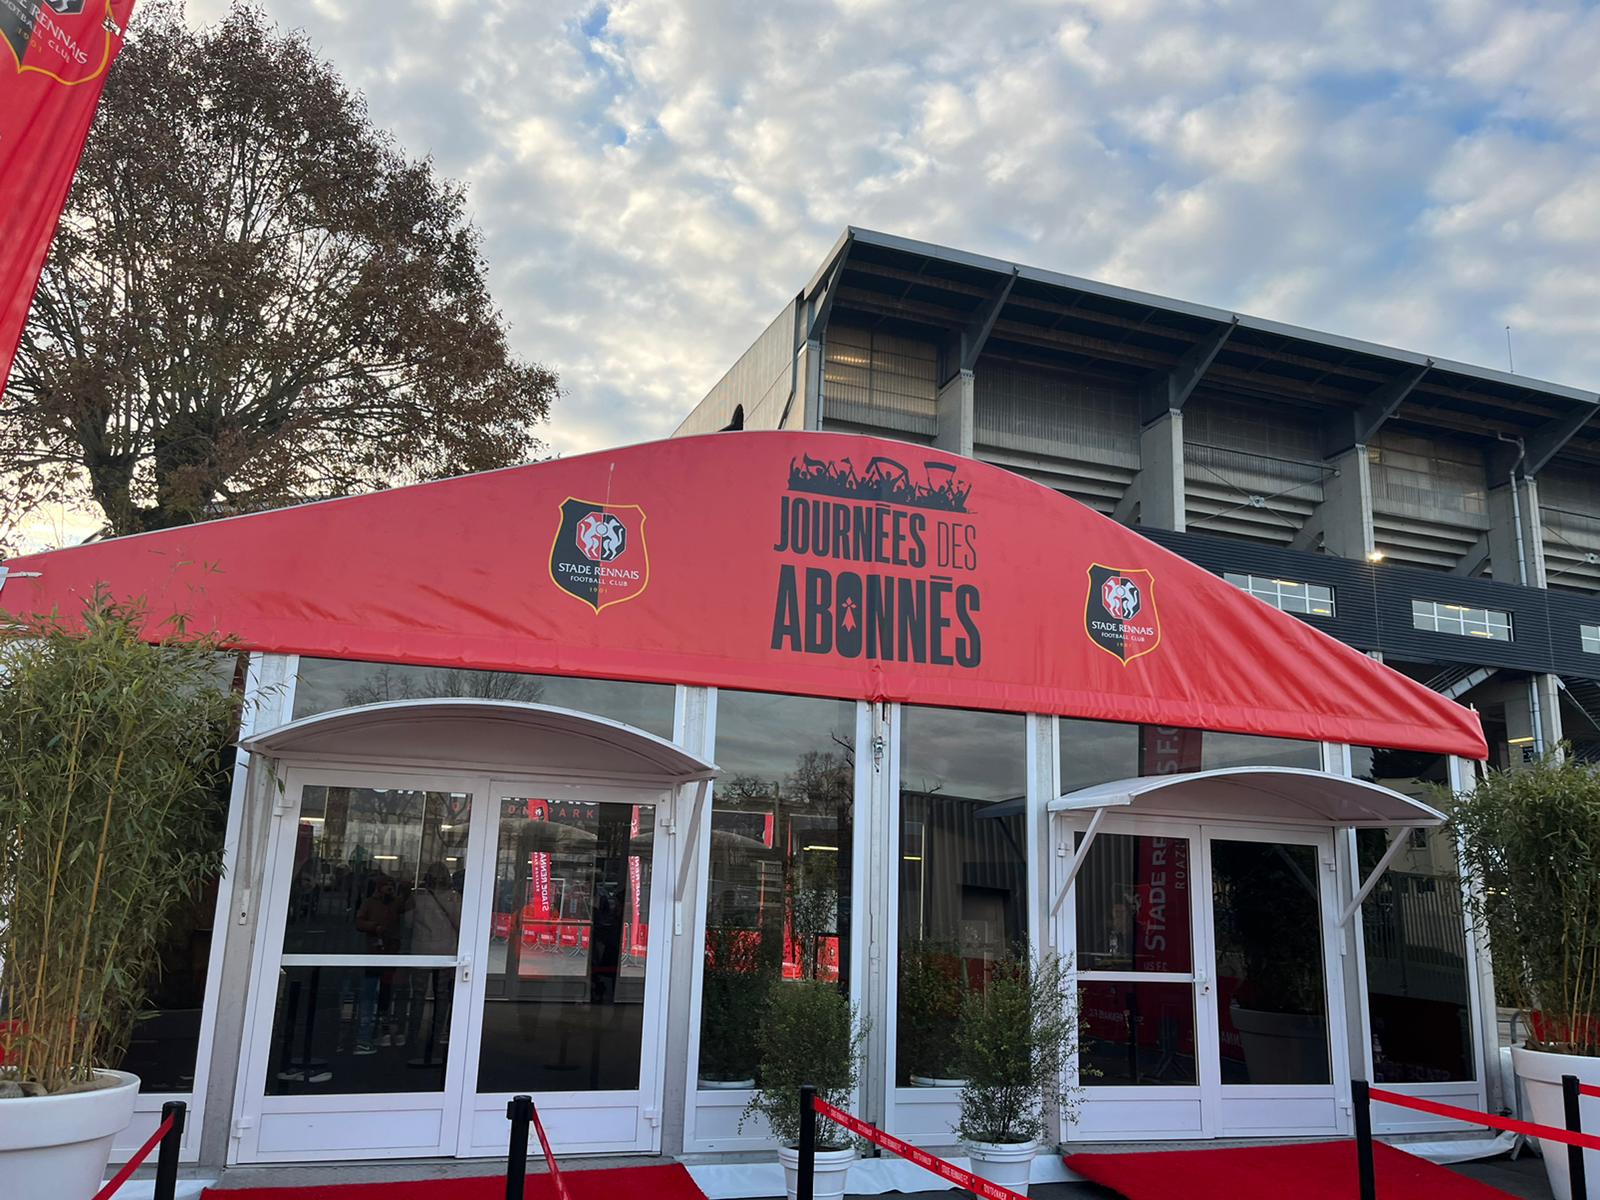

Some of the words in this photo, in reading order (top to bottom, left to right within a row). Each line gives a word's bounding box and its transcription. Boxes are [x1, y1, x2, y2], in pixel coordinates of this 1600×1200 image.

[30, 4, 88, 64] RENNAIS
[937, 521, 977, 571] DES
[558, 562, 592, 575] STADE
[594, 567, 640, 580] RENNAIS
[570, 575, 606, 585] FOOTBALL
[1091, 620, 1117, 631] STADE
[1119, 624, 1154, 636] RENNAIS
[1101, 632, 1129, 641] FOOTBALL
[1144, 871, 1167, 951] STADE
